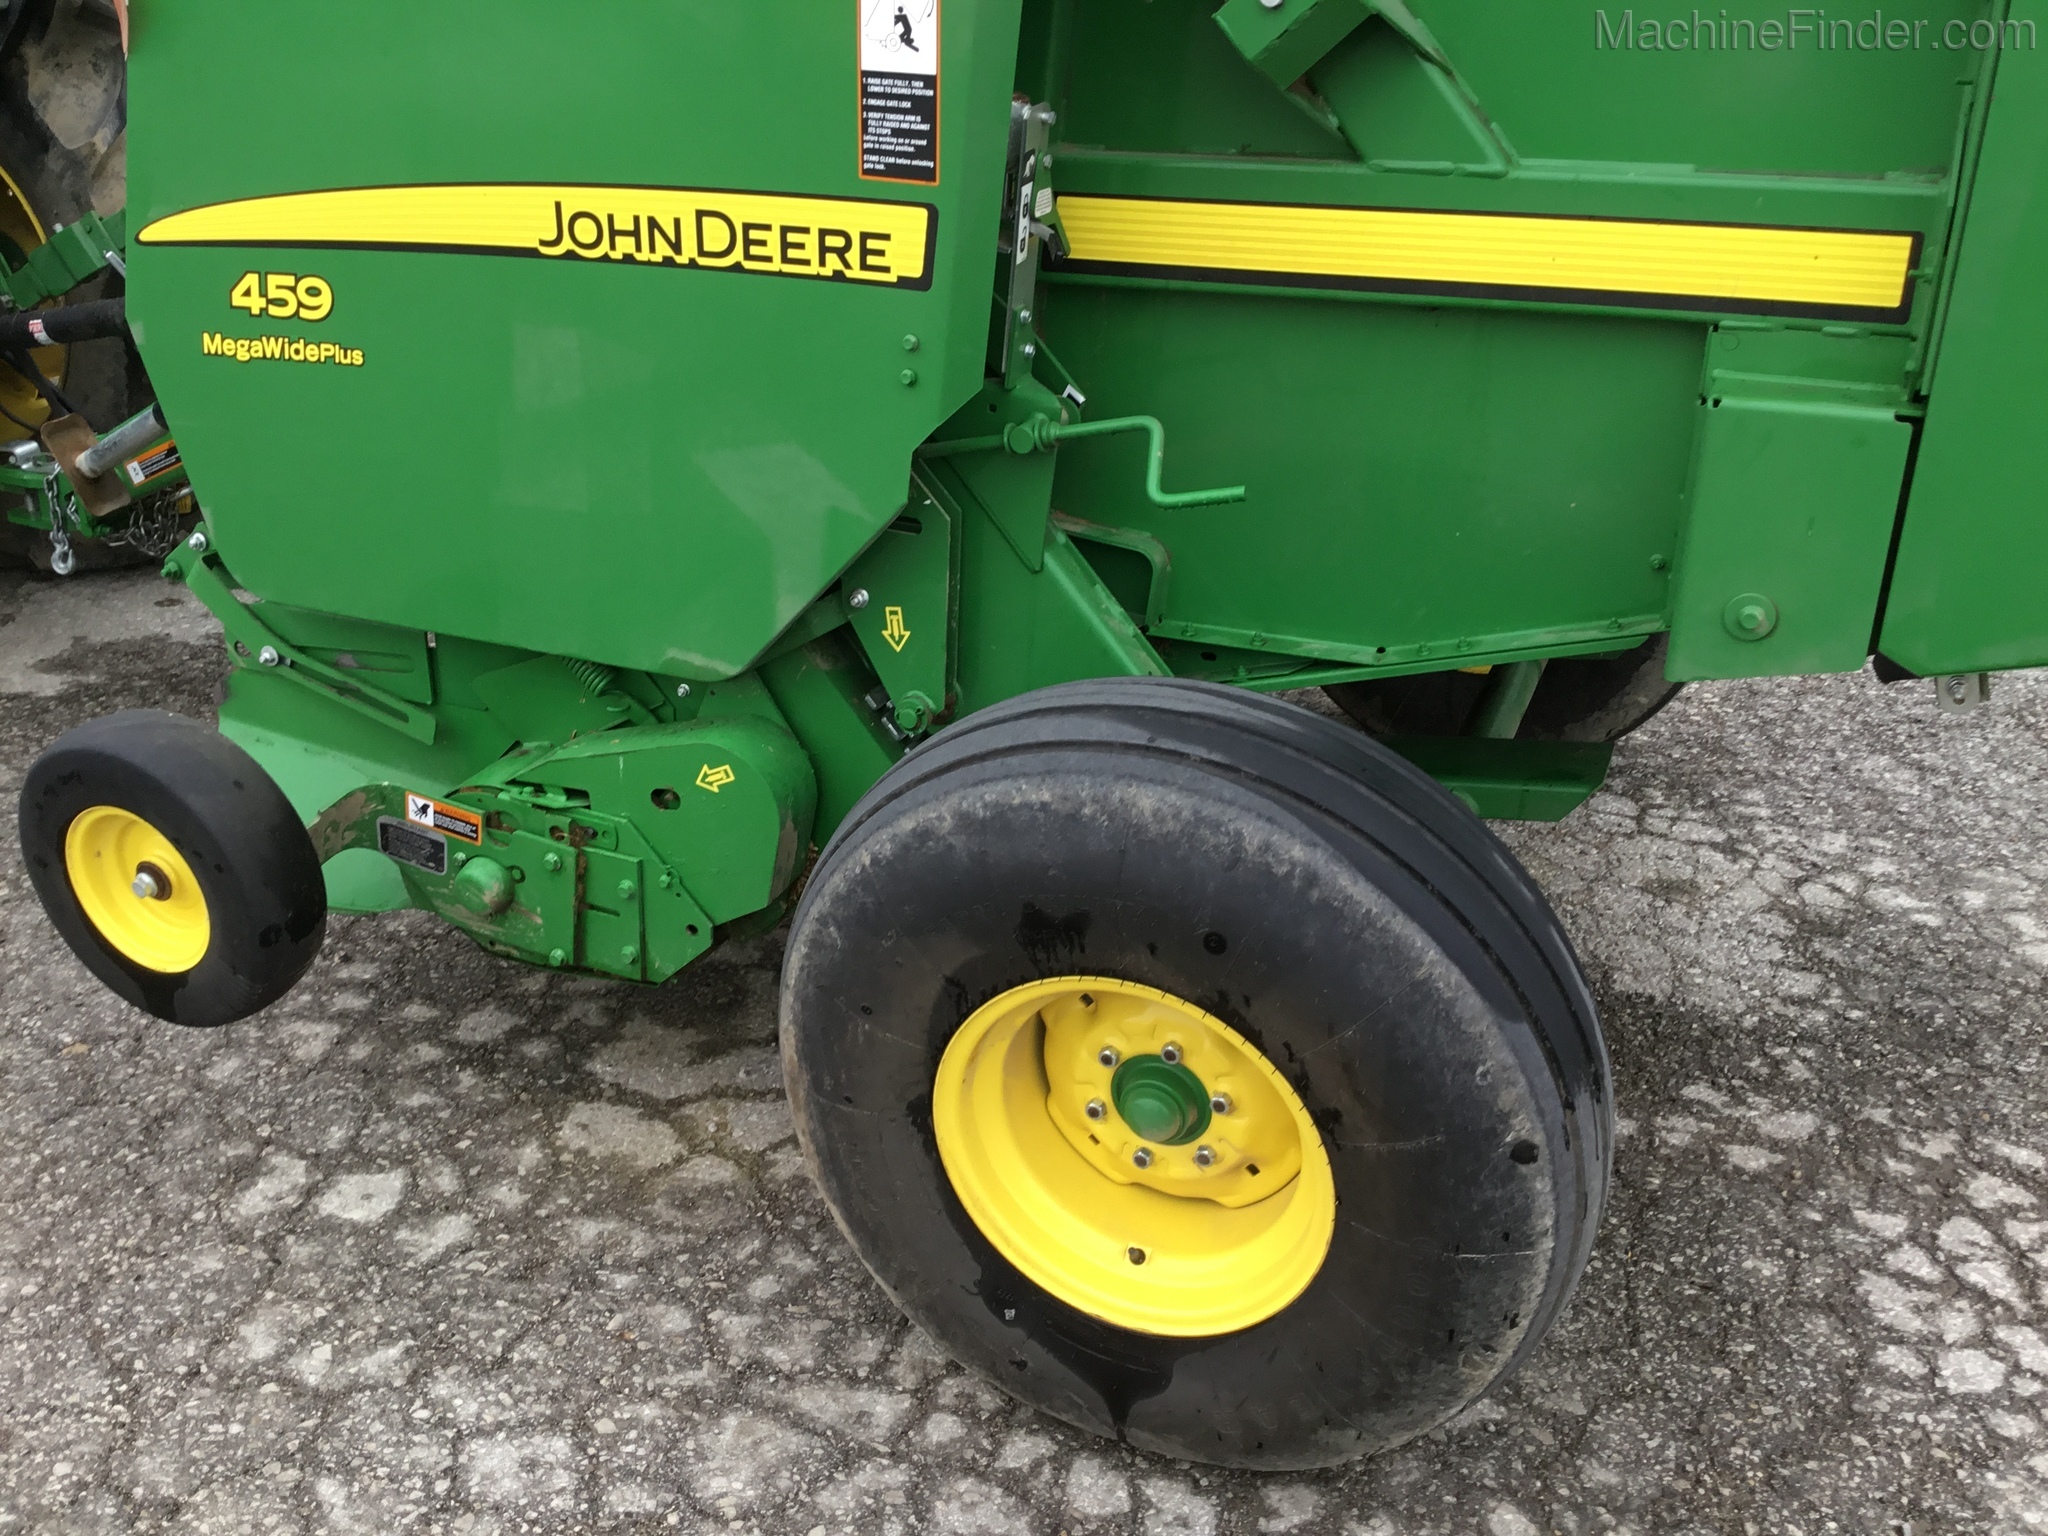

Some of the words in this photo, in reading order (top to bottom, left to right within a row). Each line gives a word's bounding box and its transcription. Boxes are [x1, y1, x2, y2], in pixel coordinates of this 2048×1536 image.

[867, 77, 881, 85] RAISE
[882, 78, 894, 86] GATE
[894, 79, 911, 87] FULLY,
[911, 80, 924, 88] THEN
[885, 86, 891, 94] TO
[892, 87, 911, 95] DESIRED
[912, 88, 934, 97] POSITION
[868, 98, 886, 106] ENGAGE
[885, 113, 904, 121] TENSION
[868, 119, 882, 127] FULLY
[910, 123, 930, 131] AGAINST
[876, 127, 891, 135] STOPS
[879, 136, 897, 144] working
[863, 154, 879, 162] STAND
[896, 157, 911, 165] before
[911, 159, 934, 168] unlocking
[538, 201, 683, 257] JOHN
[695, 209, 892, 274] DEERE
[230, 270, 334, 322] 459
[202, 331, 365, 366] MegaWidePlus
